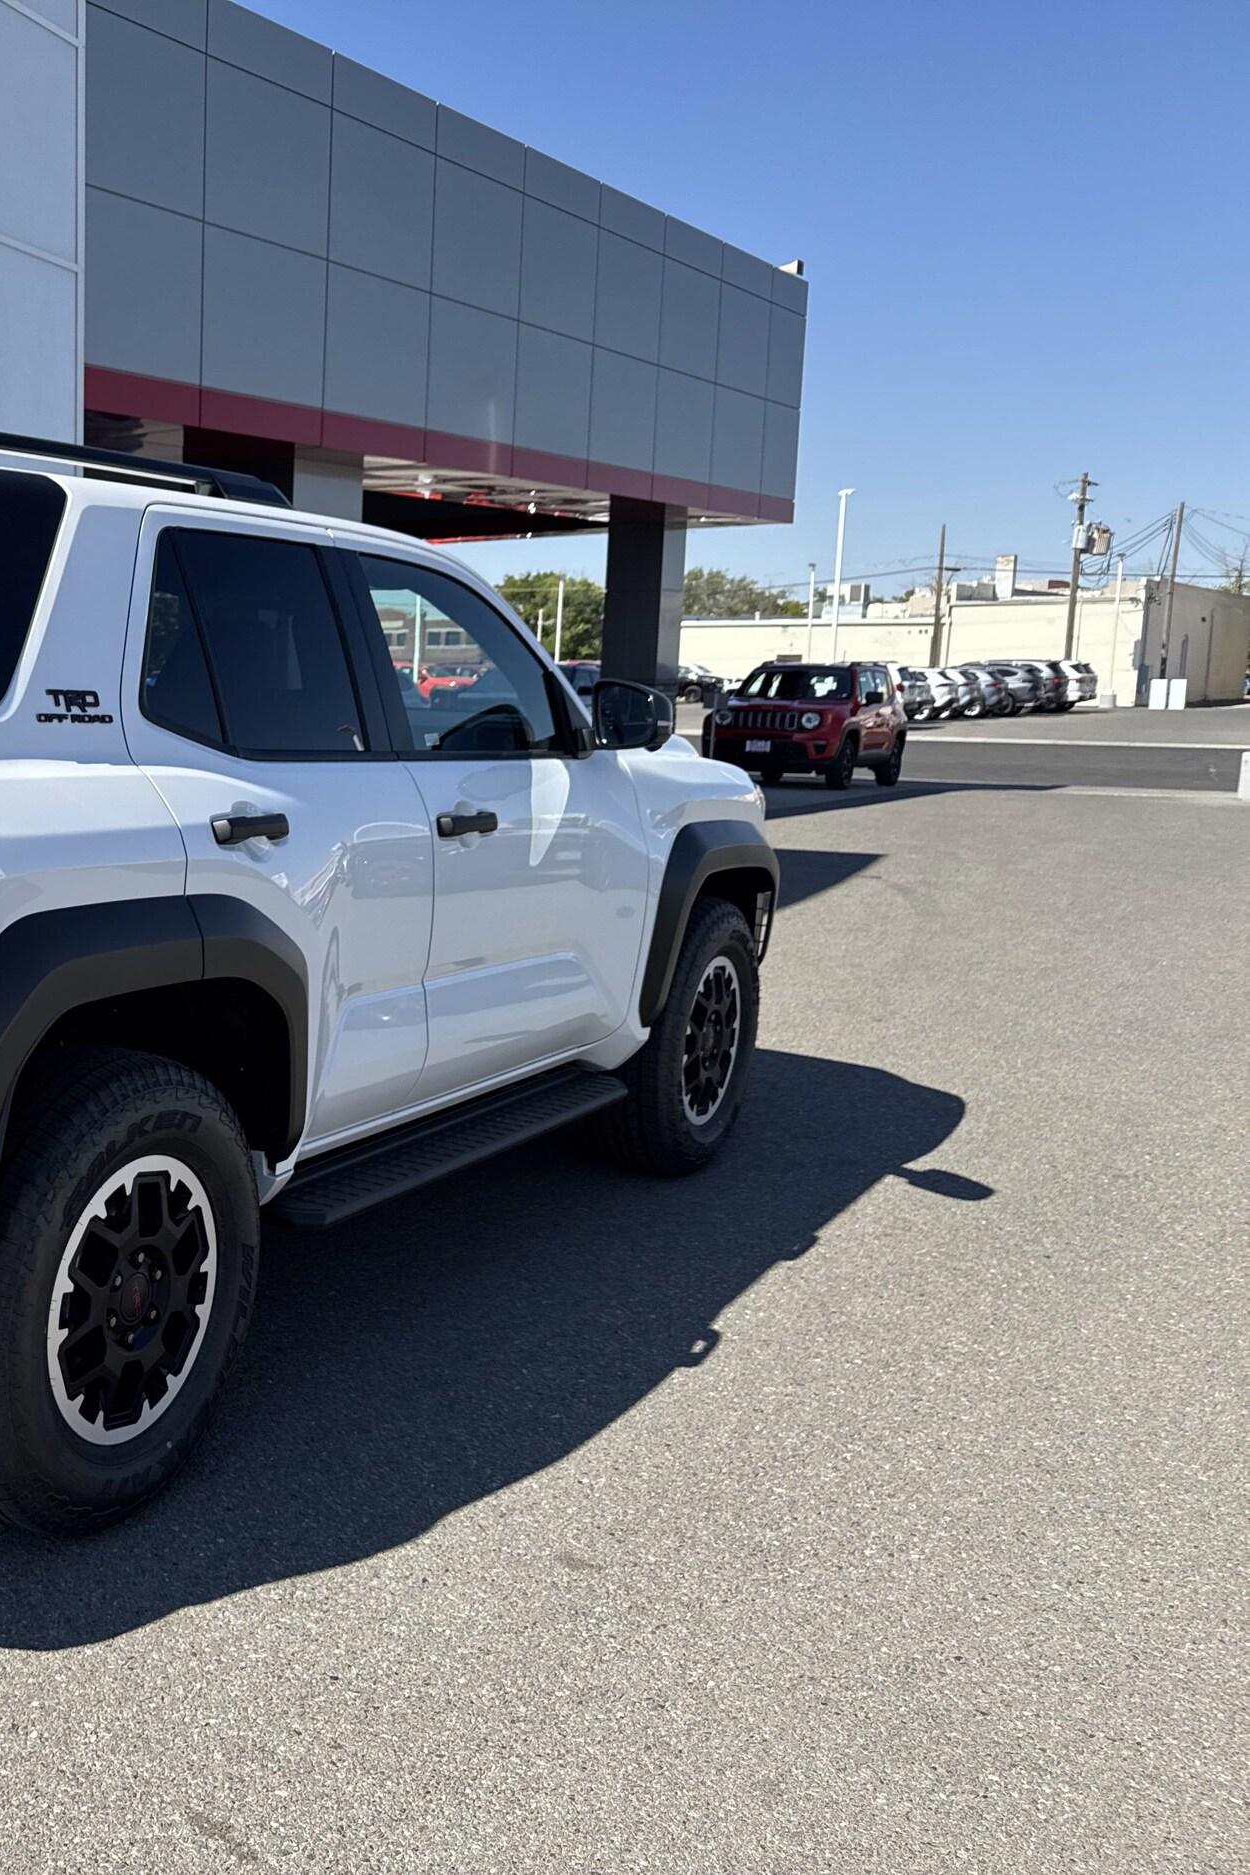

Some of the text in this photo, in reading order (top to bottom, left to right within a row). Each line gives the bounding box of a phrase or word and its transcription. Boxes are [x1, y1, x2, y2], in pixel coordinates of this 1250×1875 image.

[45, 689, 100, 713] TRD
[36, 713, 114, 724] OFF ROAD
